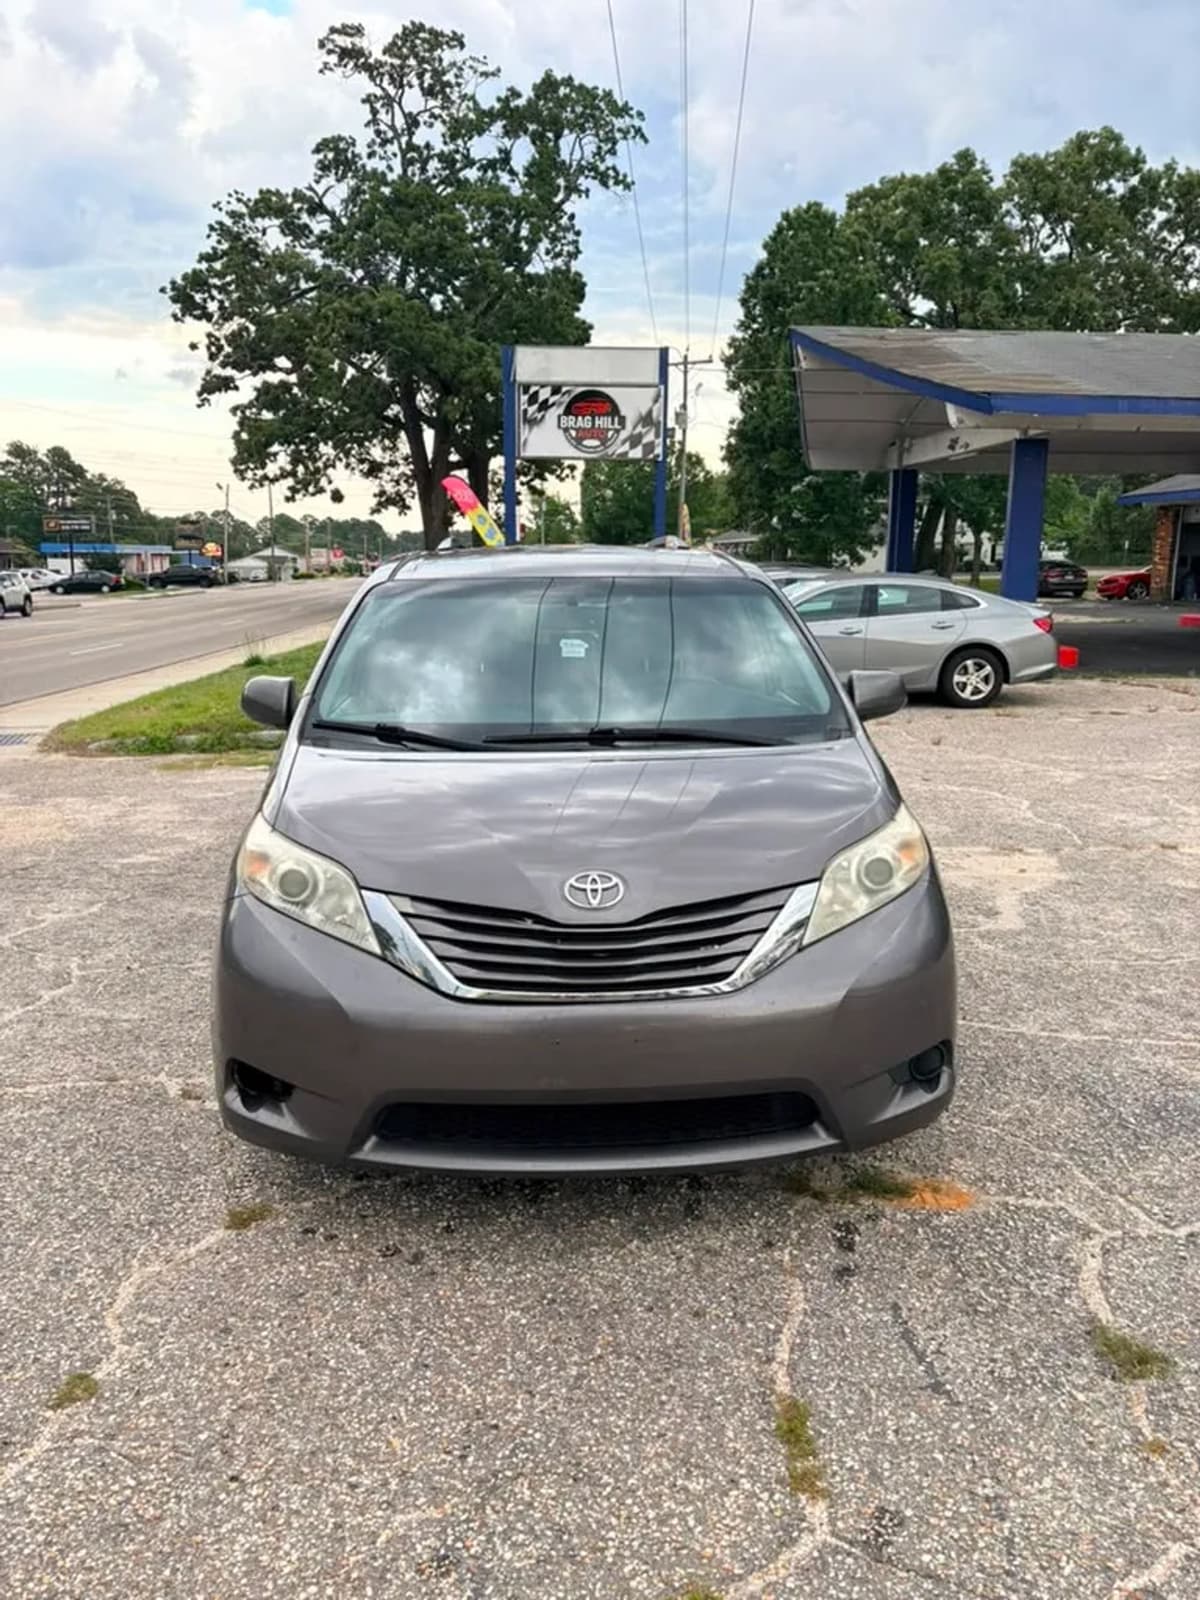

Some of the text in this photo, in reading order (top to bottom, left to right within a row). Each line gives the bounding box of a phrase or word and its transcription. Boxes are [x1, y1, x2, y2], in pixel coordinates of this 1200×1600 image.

[560, 415, 621, 429] BRAG HILL
[577, 429, 606, 439] AUTO
